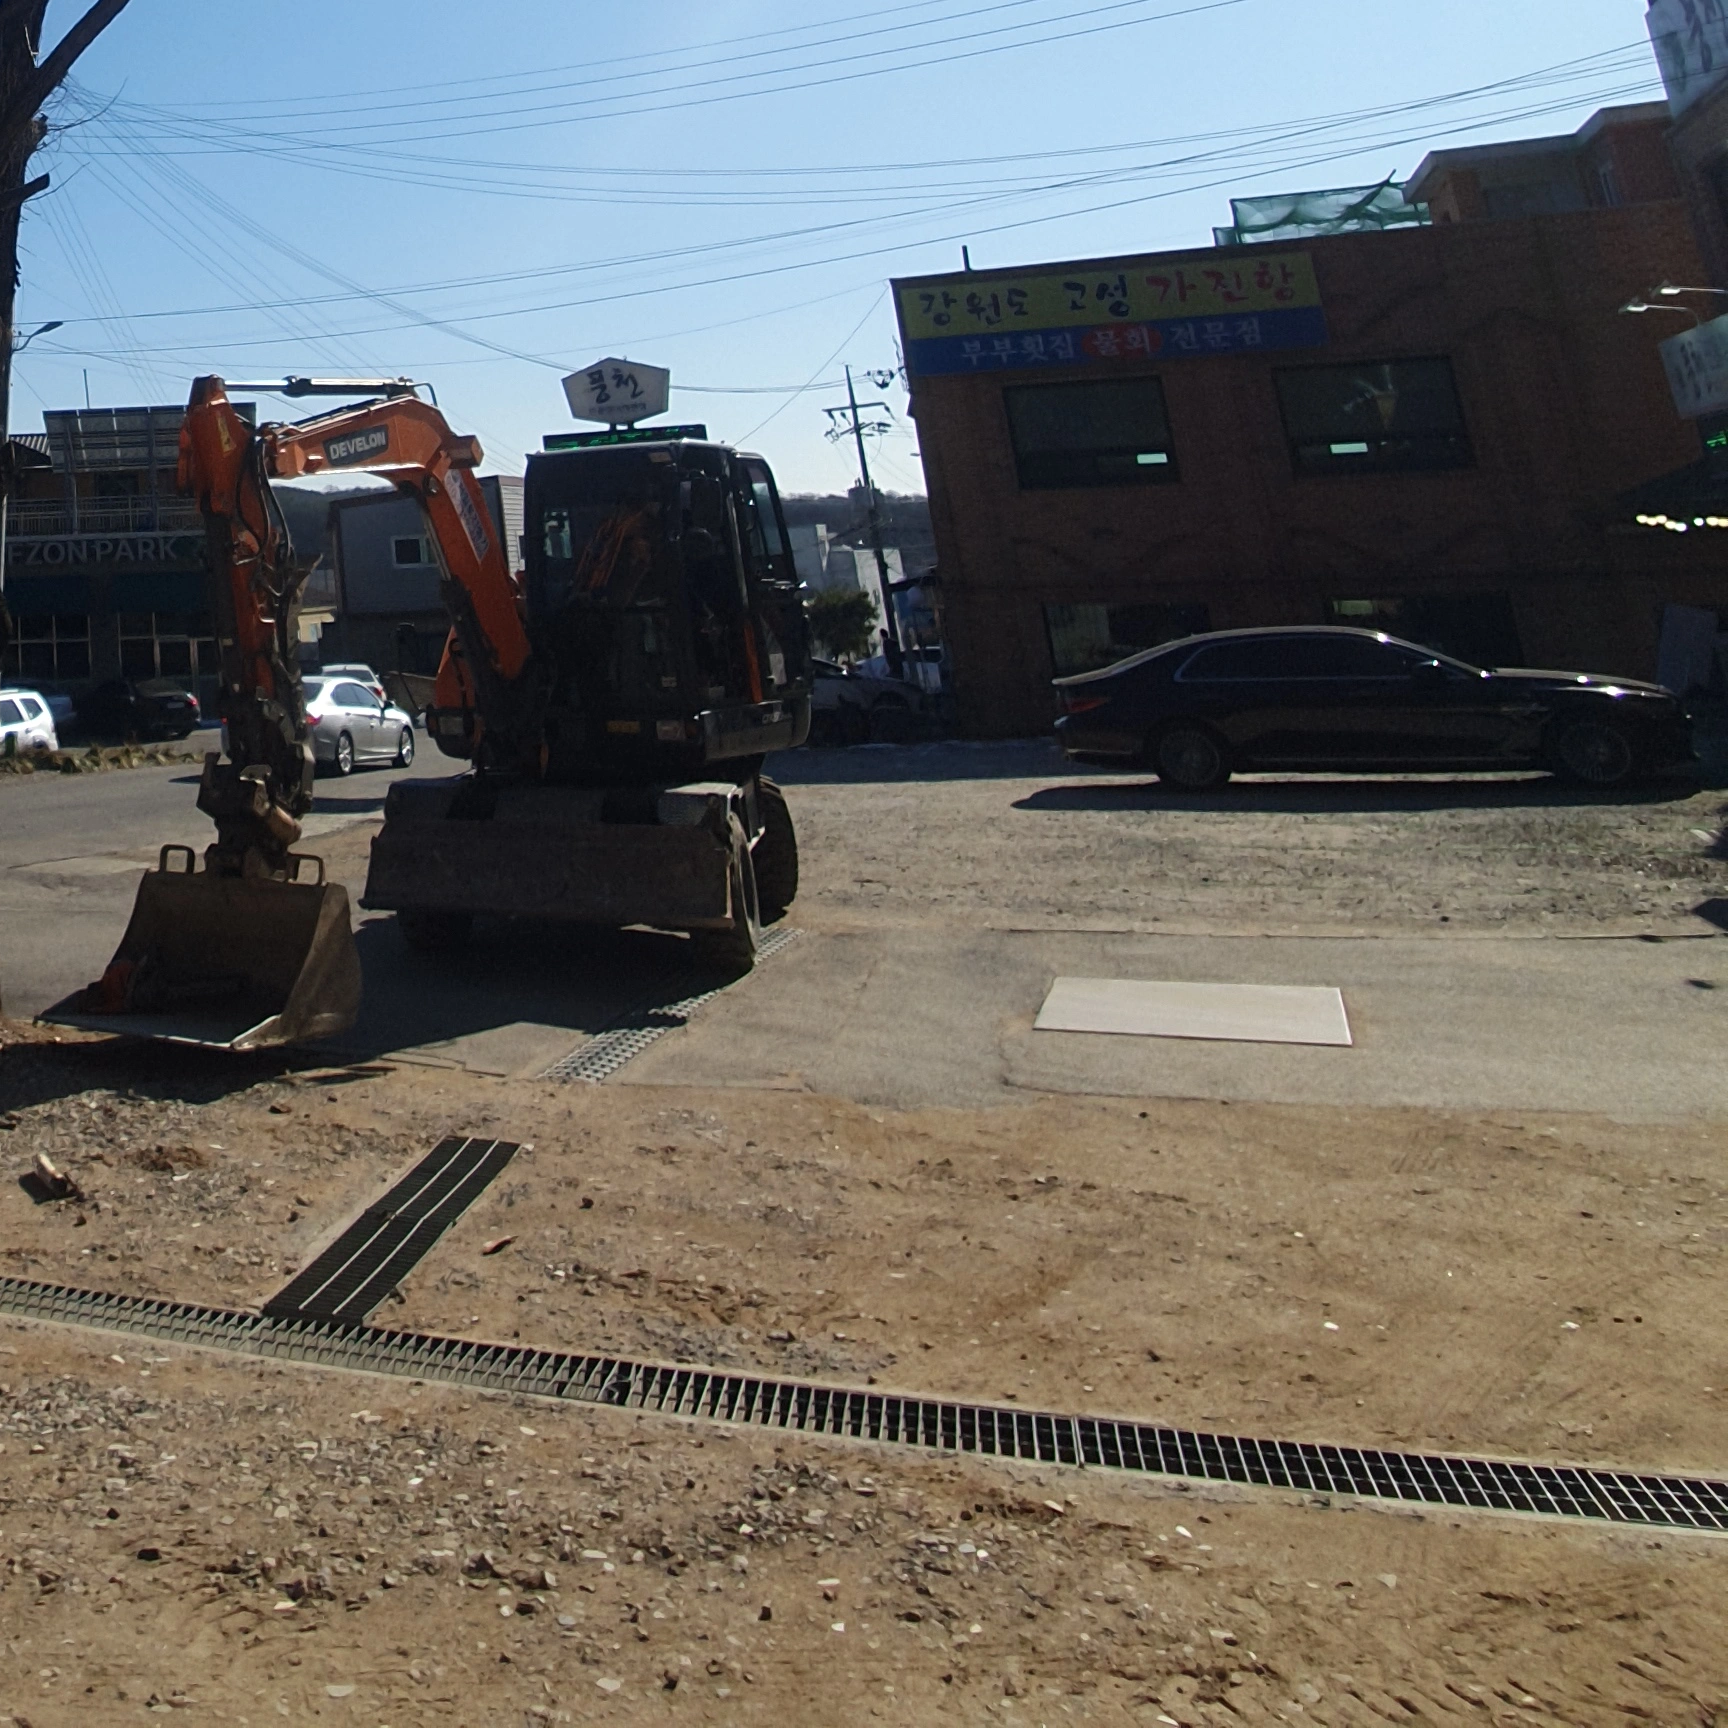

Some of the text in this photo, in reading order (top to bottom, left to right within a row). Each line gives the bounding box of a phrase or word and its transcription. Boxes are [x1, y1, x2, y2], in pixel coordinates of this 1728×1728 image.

[920, 261, 1295, 326] 강원도 고성 가진항
[961, 317, 1263, 366] 부부횟집 물회 전문점
[587, 368, 644, 404] 풍천
[329, 431, 386, 460] DEVELON
[94, 535, 179, 563] PARK
